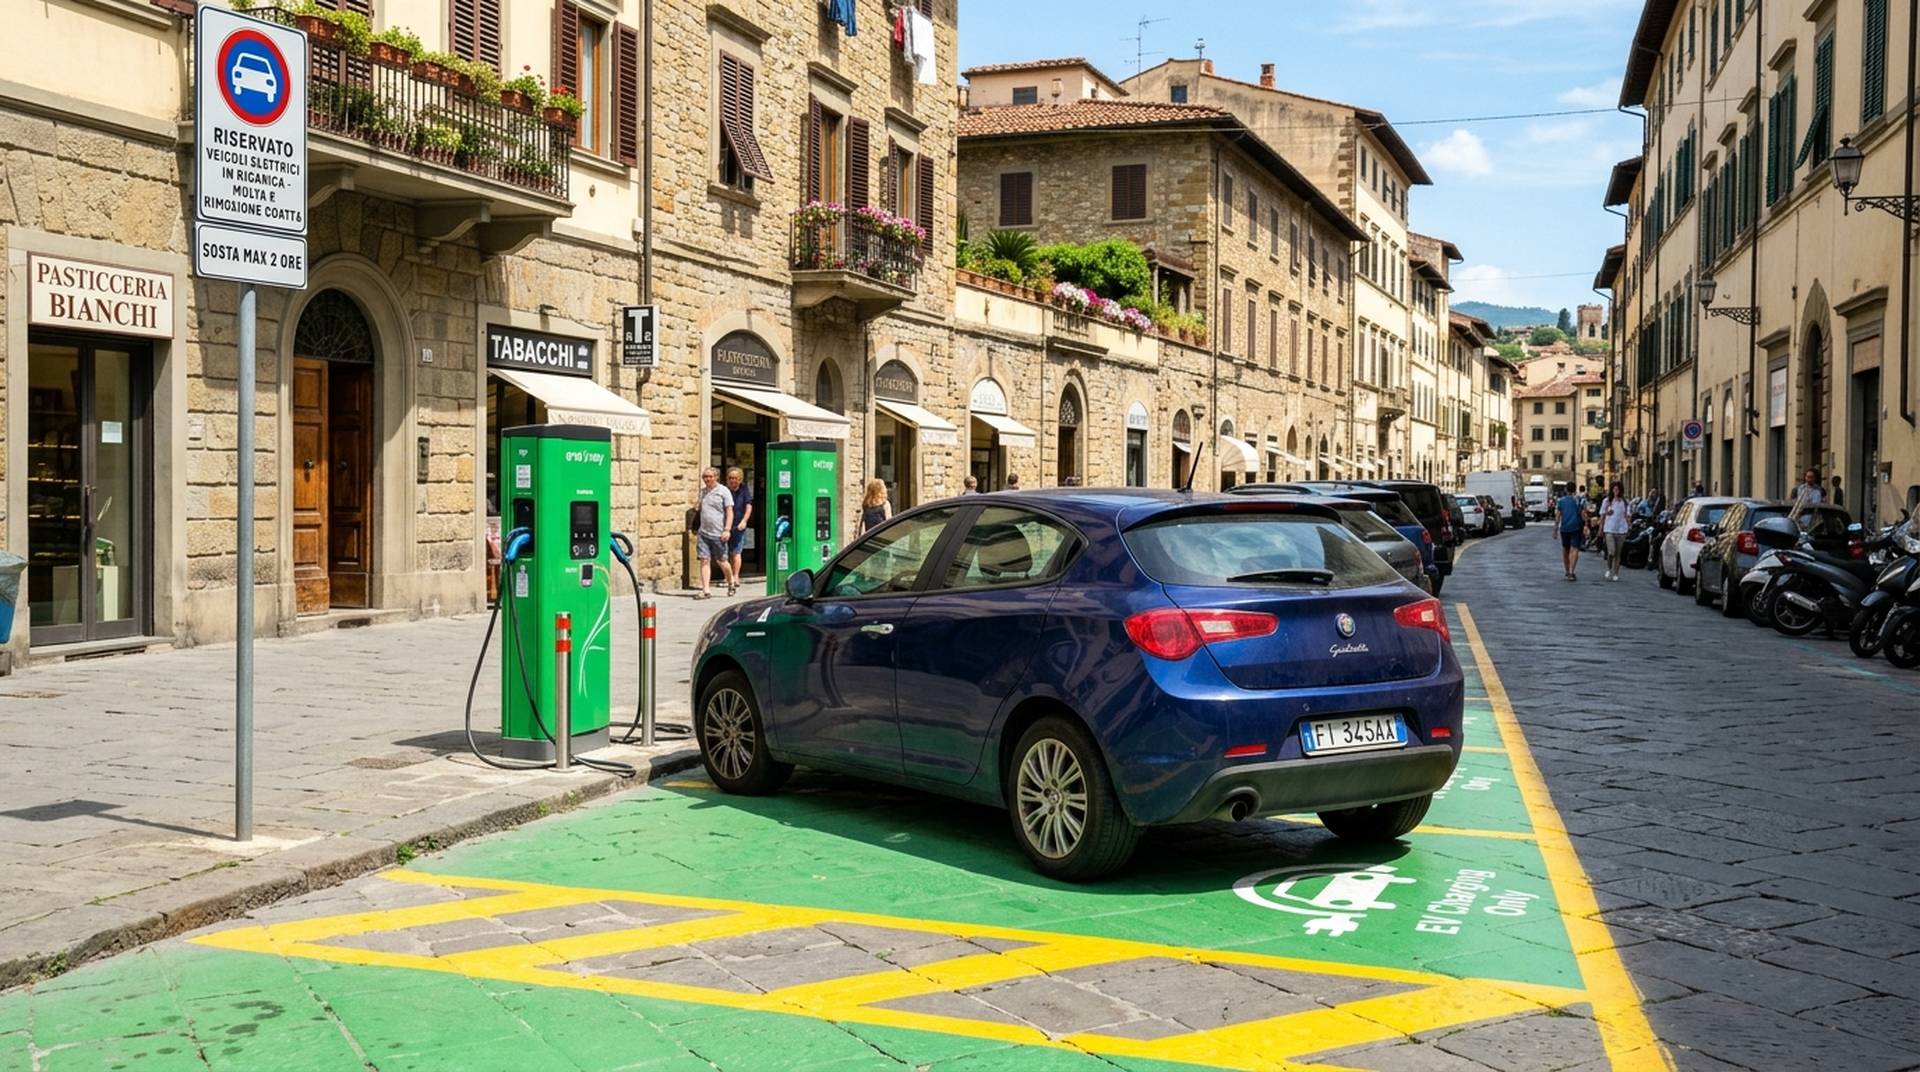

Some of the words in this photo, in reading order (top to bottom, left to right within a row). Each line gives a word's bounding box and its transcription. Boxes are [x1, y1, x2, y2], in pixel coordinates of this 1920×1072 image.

[206, 147, 248, 167] VEICOLI
[214, 127, 294, 158] RISERVATO
[222, 167, 234, 180] IN
[202, 242, 240, 262] SOSTA
[243, 248, 267, 266] MAX
[270, 252, 277, 267] 2
[280, 255, 302, 270] ORE
[37, 262, 168, 300] PASTICCERIA
[49, 292, 157, 329] BIANCHI
[628, 309, 650, 344] T
[490, 334, 574, 368] TABACCHI
[1314, 723, 1335, 746] FI
[1426, 869, 1497, 915] Charging
[1483, 889, 1540, 916] Only
[1415, 914, 1463, 935] EV
